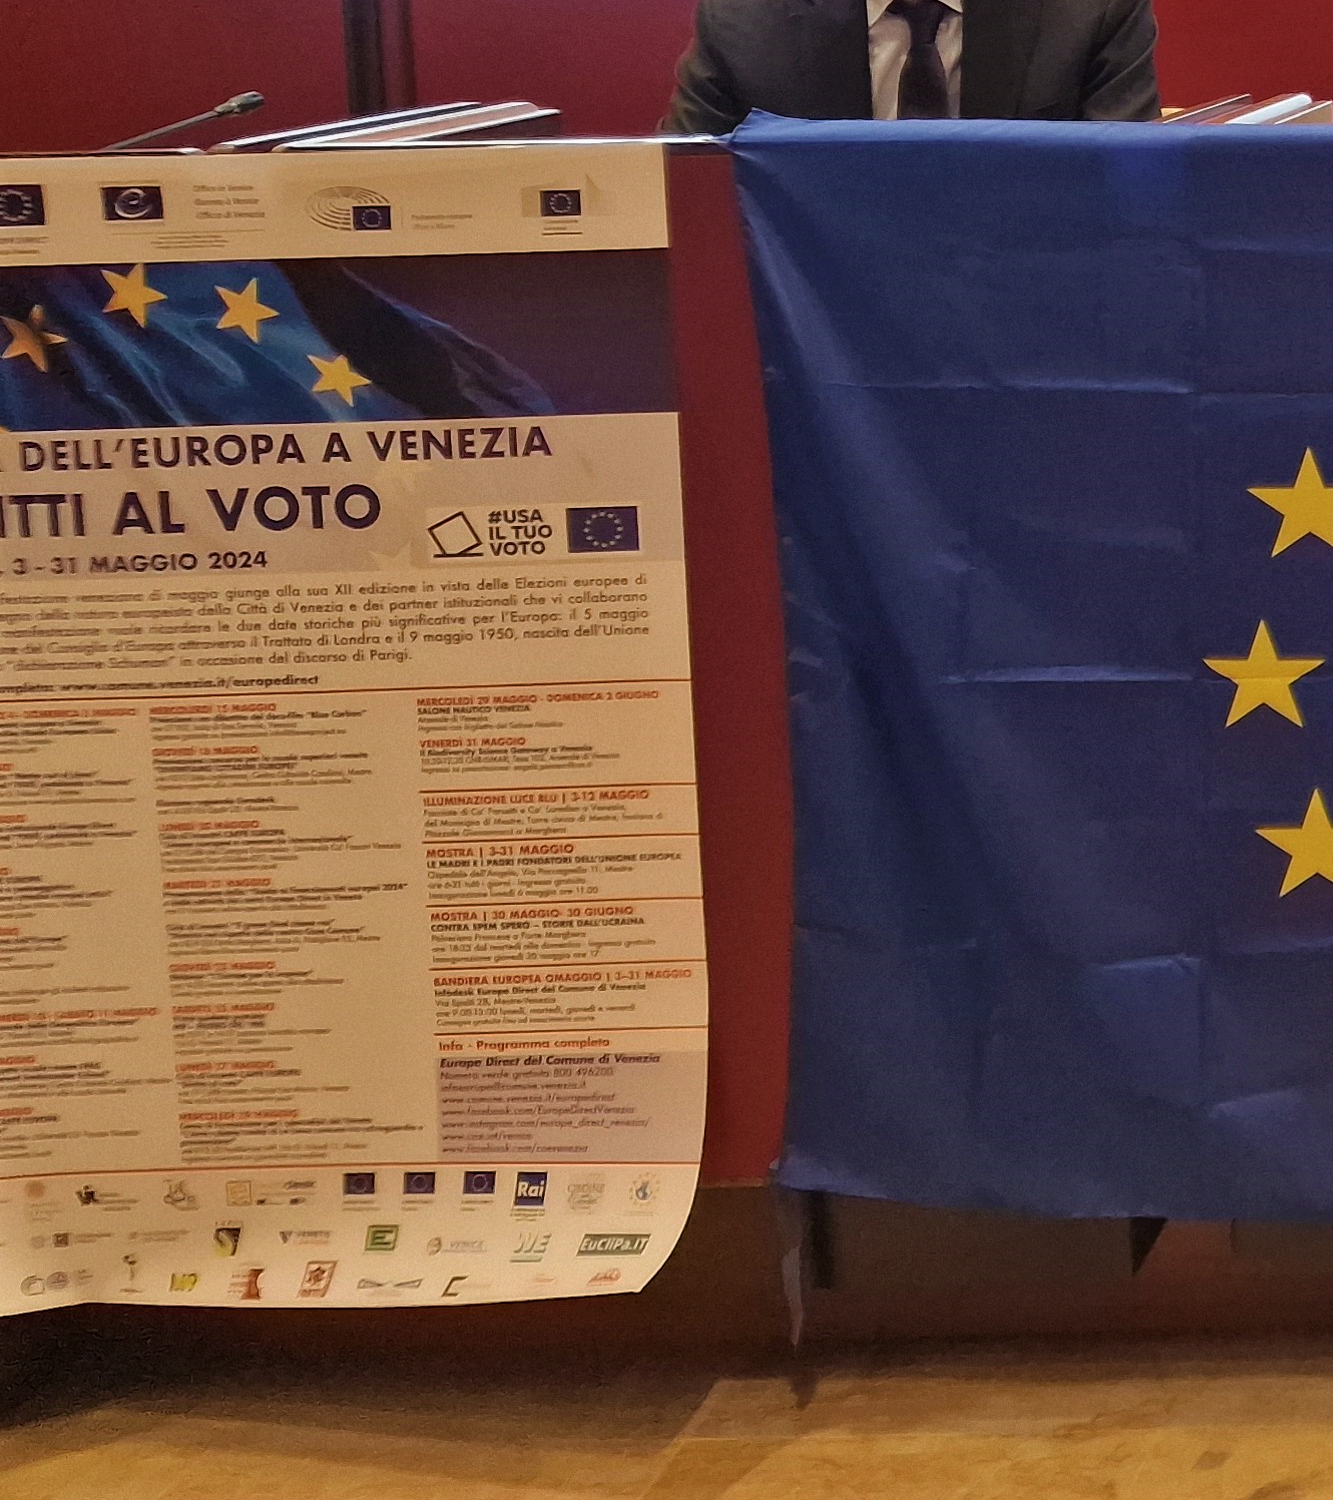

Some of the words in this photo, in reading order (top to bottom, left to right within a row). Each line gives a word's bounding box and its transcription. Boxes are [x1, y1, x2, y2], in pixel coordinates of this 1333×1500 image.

[19, 432, 305, 471] DELL'EUROPA
[322, 432, 351, 462] A
[366, 426, 551, 461] VENEZIA
[0, 492, 84, 538] ITTI
[113, 490, 184, 535] AL
[206, 483, 380, 533] VOTO
[488, 509, 543, 523] #USA
[489, 526, 506, 540] IL
[511, 525, 552, 539] TUO
[490, 541, 545, 556] VOTO
[14, 558, 26, 575] 3
[51, 556, 75, 574] 31
[90, 553, 197, 573] MAGGIO
[208, 550, 267, 569] 2024
[517, 1180, 544, 1198] Rai
